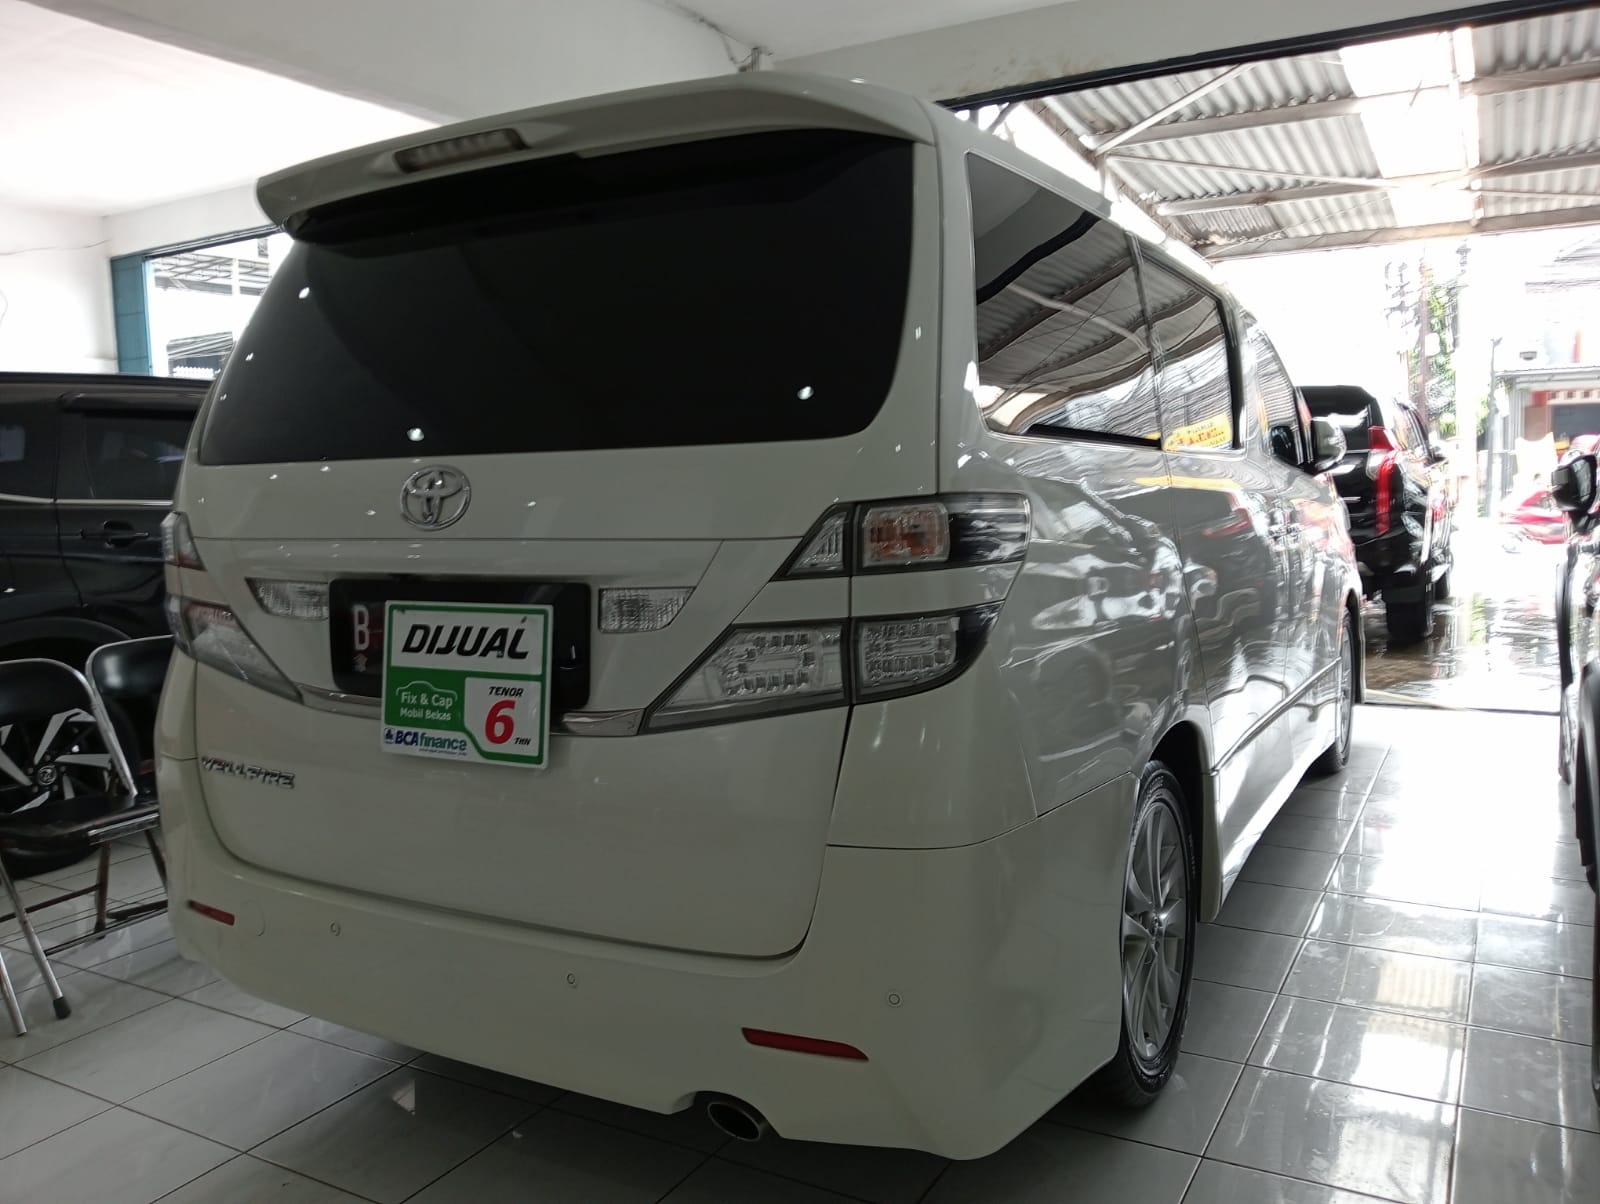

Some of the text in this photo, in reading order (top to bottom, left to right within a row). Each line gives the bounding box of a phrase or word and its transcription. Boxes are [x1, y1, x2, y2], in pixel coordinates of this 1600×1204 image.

[353, 603, 370, 651] B
[402, 623, 529, 660] DIJUAL
[401, 691, 453, 710] Fix & Cap
[488, 686, 524, 698] TENOR
[399, 707, 452, 721] Mobil Bekas
[485, 699, 516, 745] 6
